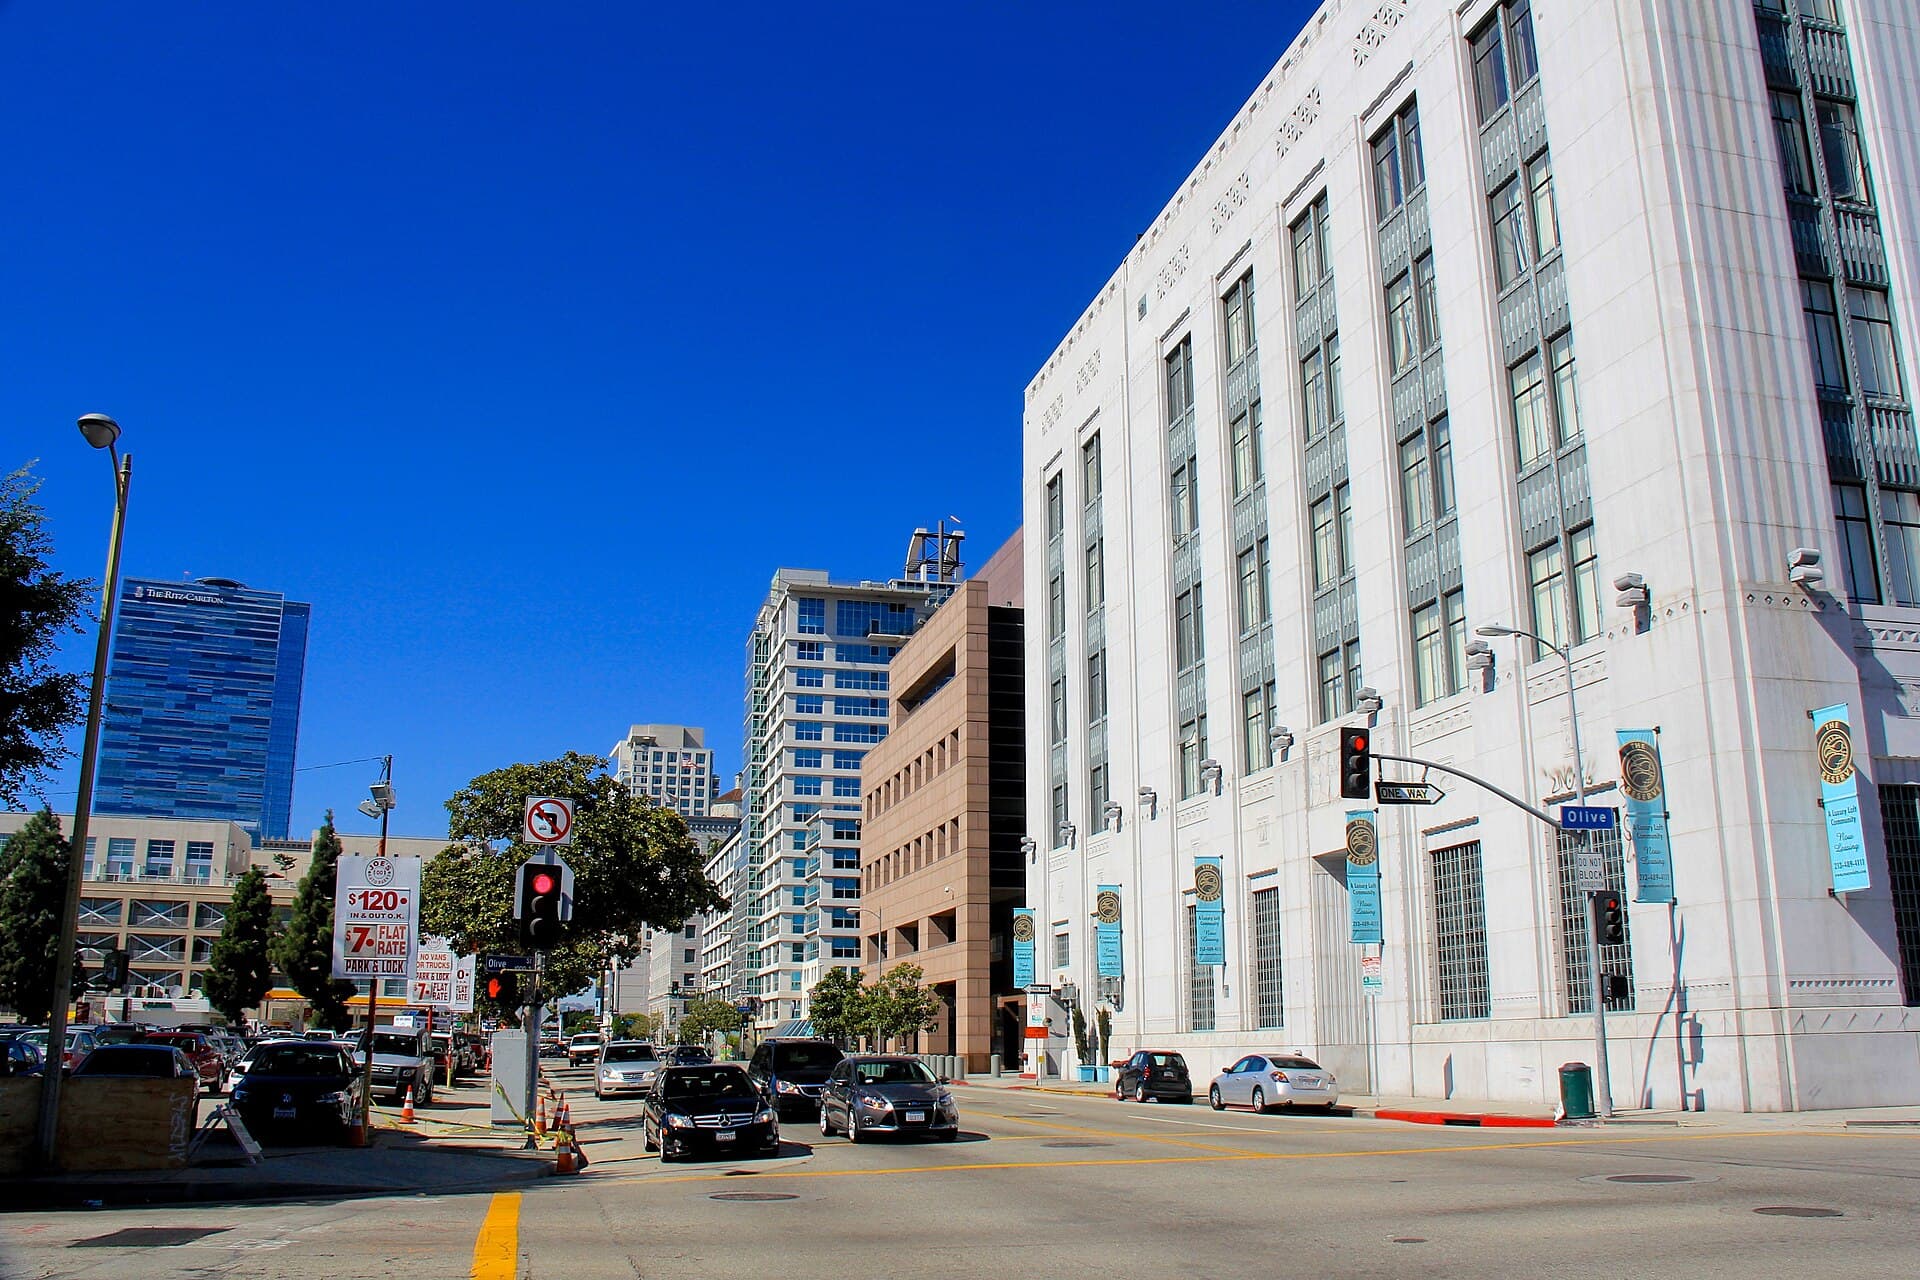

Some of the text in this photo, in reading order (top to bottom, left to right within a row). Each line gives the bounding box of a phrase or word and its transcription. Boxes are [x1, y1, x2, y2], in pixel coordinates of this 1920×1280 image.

[1824, 721, 1840, 730] THE
[1381, 787, 1427, 799] ONE WAY
[1568, 810, 1607, 823] Olive
[369, 861, 391, 871] JOE'S
[1578, 858, 1601, 867] DO NOT
[1579, 870, 1603, 880] BLOCK
[379, 925, 406, 940] FLAT
[377, 941, 406, 956] RATE
[431, 953, 447, 961] VANS
[345, 960, 404, 973] PARK & LOCK
[426, 961, 450, 969] TRUCKS
[488, 958, 507, 968] Olive
[436, 972, 450, 980] LOCK
[433, 982, 448, 991] FLAT
[432, 992, 448, 1001] RATE
